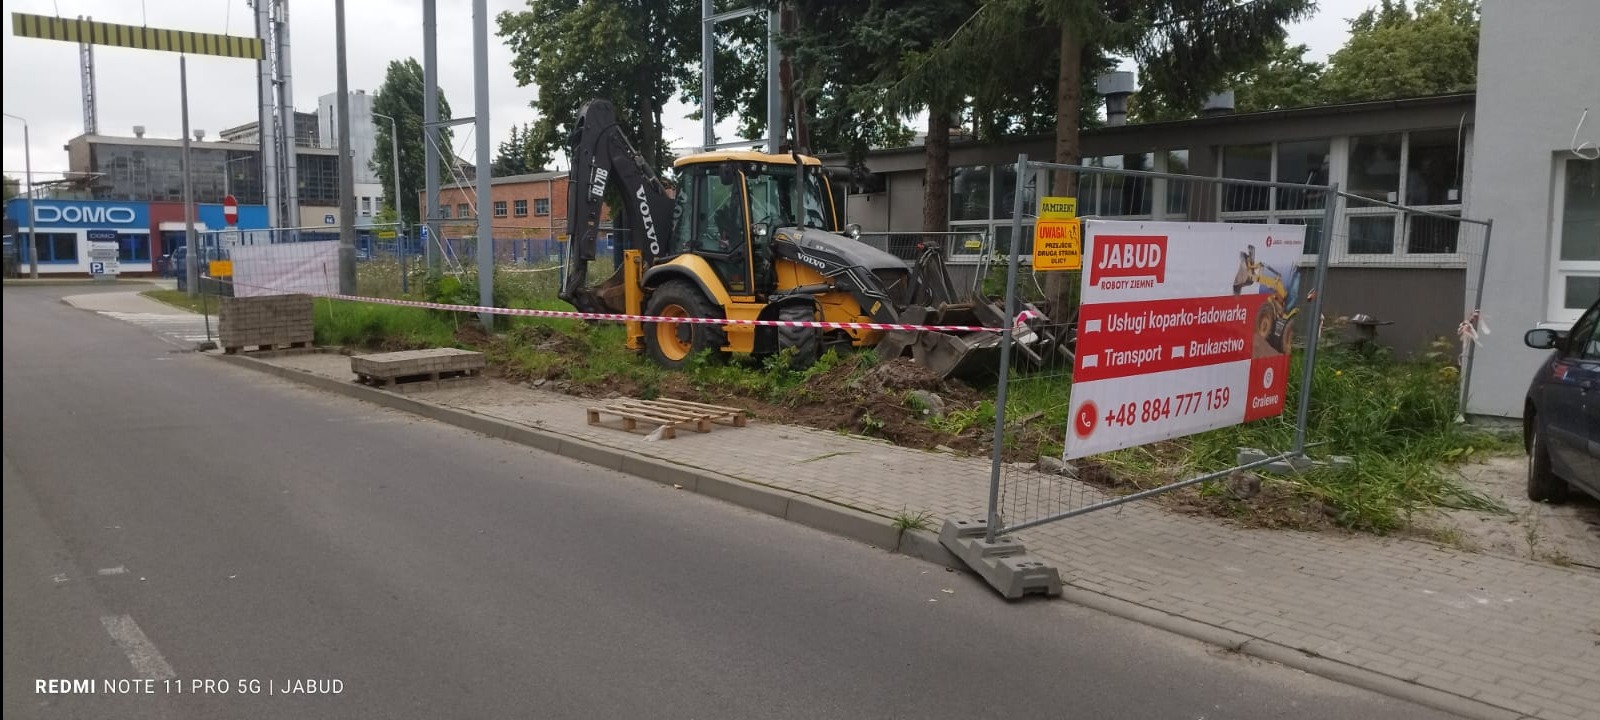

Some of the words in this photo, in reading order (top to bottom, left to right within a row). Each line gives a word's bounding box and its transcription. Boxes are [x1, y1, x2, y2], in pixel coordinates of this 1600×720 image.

[592, 167, 608, 197] BL71B
[34, 206, 136, 223] DOMO
[636, 184, 660, 255] VOLVO
[1040, 227, 1067, 239] UWAGA!
[797, 252, 826, 269] VOLVO
[1099, 243, 1161, 270] JABUD
[1101, 280, 1129, 290] ROBOTY
[1130, 279, 1154, 289] ZIEMNE
[1107, 311, 1147, 334] Usługi
[1149, 304, 1247, 332] koparko-ładowarką
[1105, 344, 1162, 367] Transport
[1189, 337, 1245, 357] Brukarstwo
[1105, 402, 1137, 427] +48
[1141, 397, 1171, 423] 884
[1175, 391, 1203, 417] 777
[1207, 386, 1230, 411] 159
[1252, 393, 1279, 409] Gralewo
